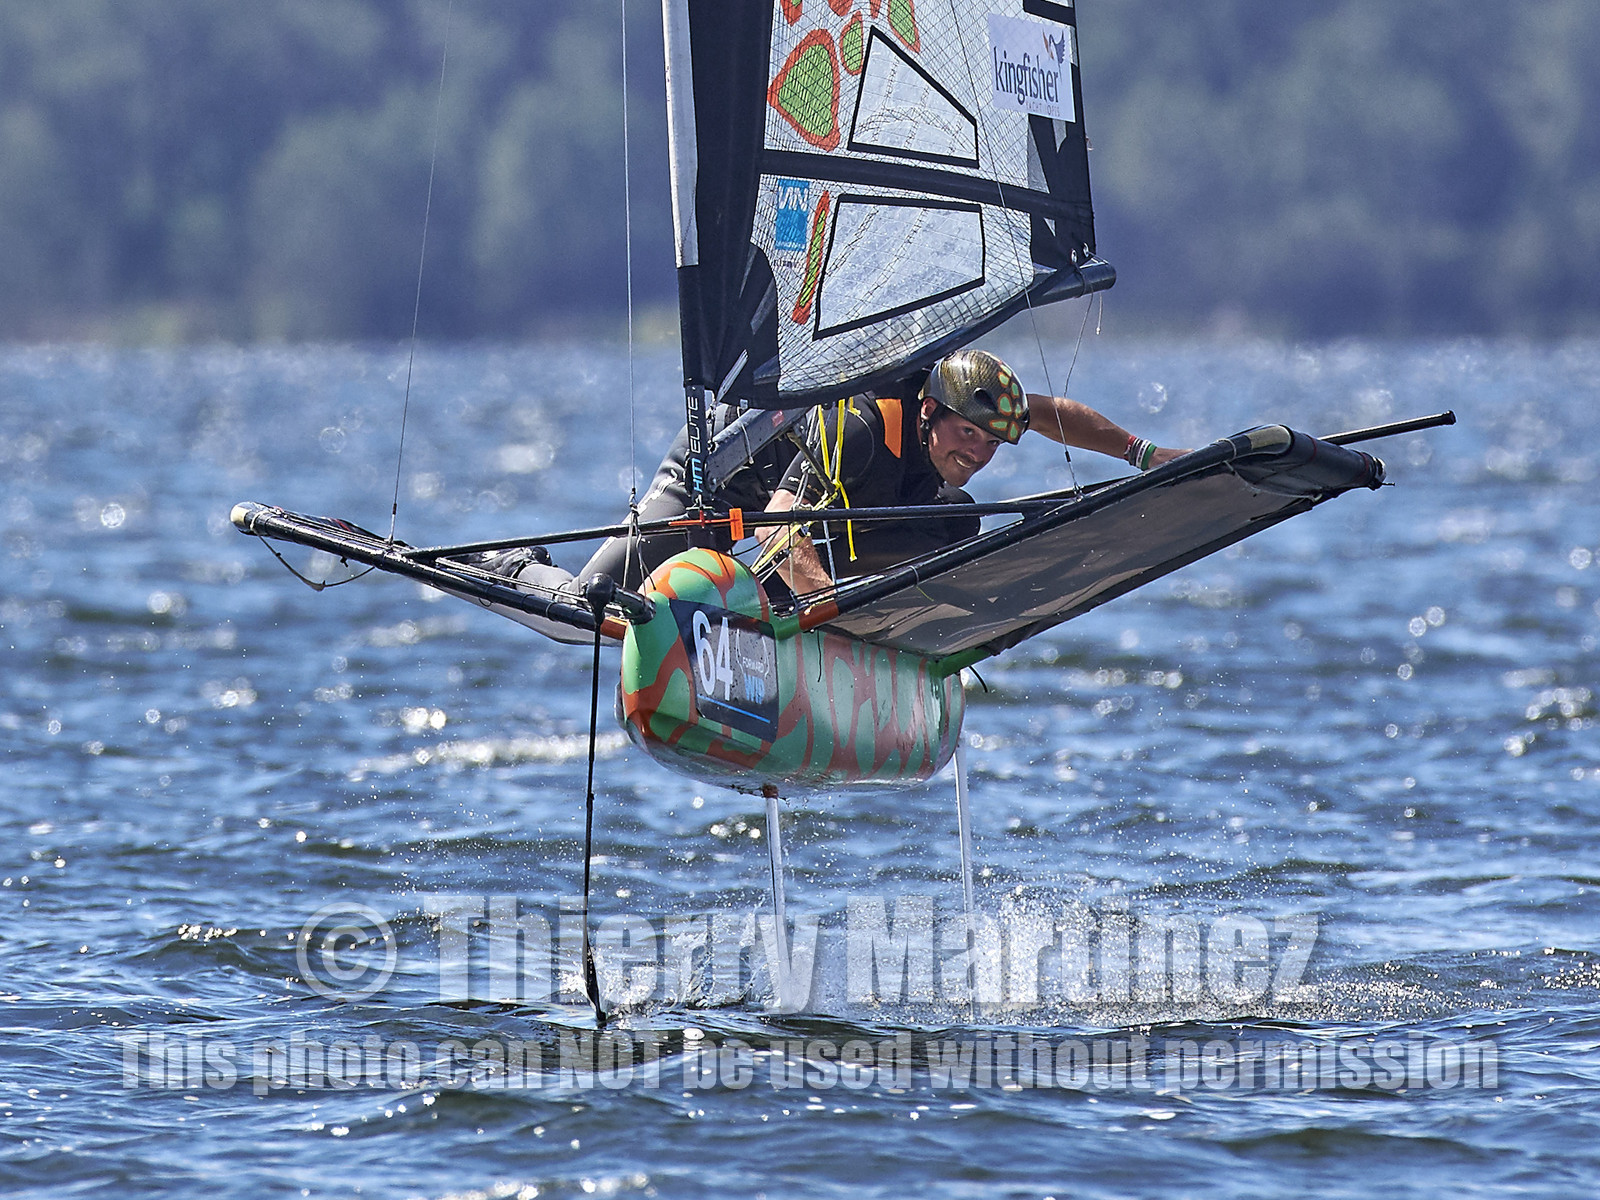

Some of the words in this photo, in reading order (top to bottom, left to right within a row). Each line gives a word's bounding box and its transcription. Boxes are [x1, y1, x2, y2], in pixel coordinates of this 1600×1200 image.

[994, 46, 1060, 105] kingfisher
[686, 395, 701, 454] ELITE
[692, 610, 734, 701] 64
[742, 656, 765, 674] FORWARD
